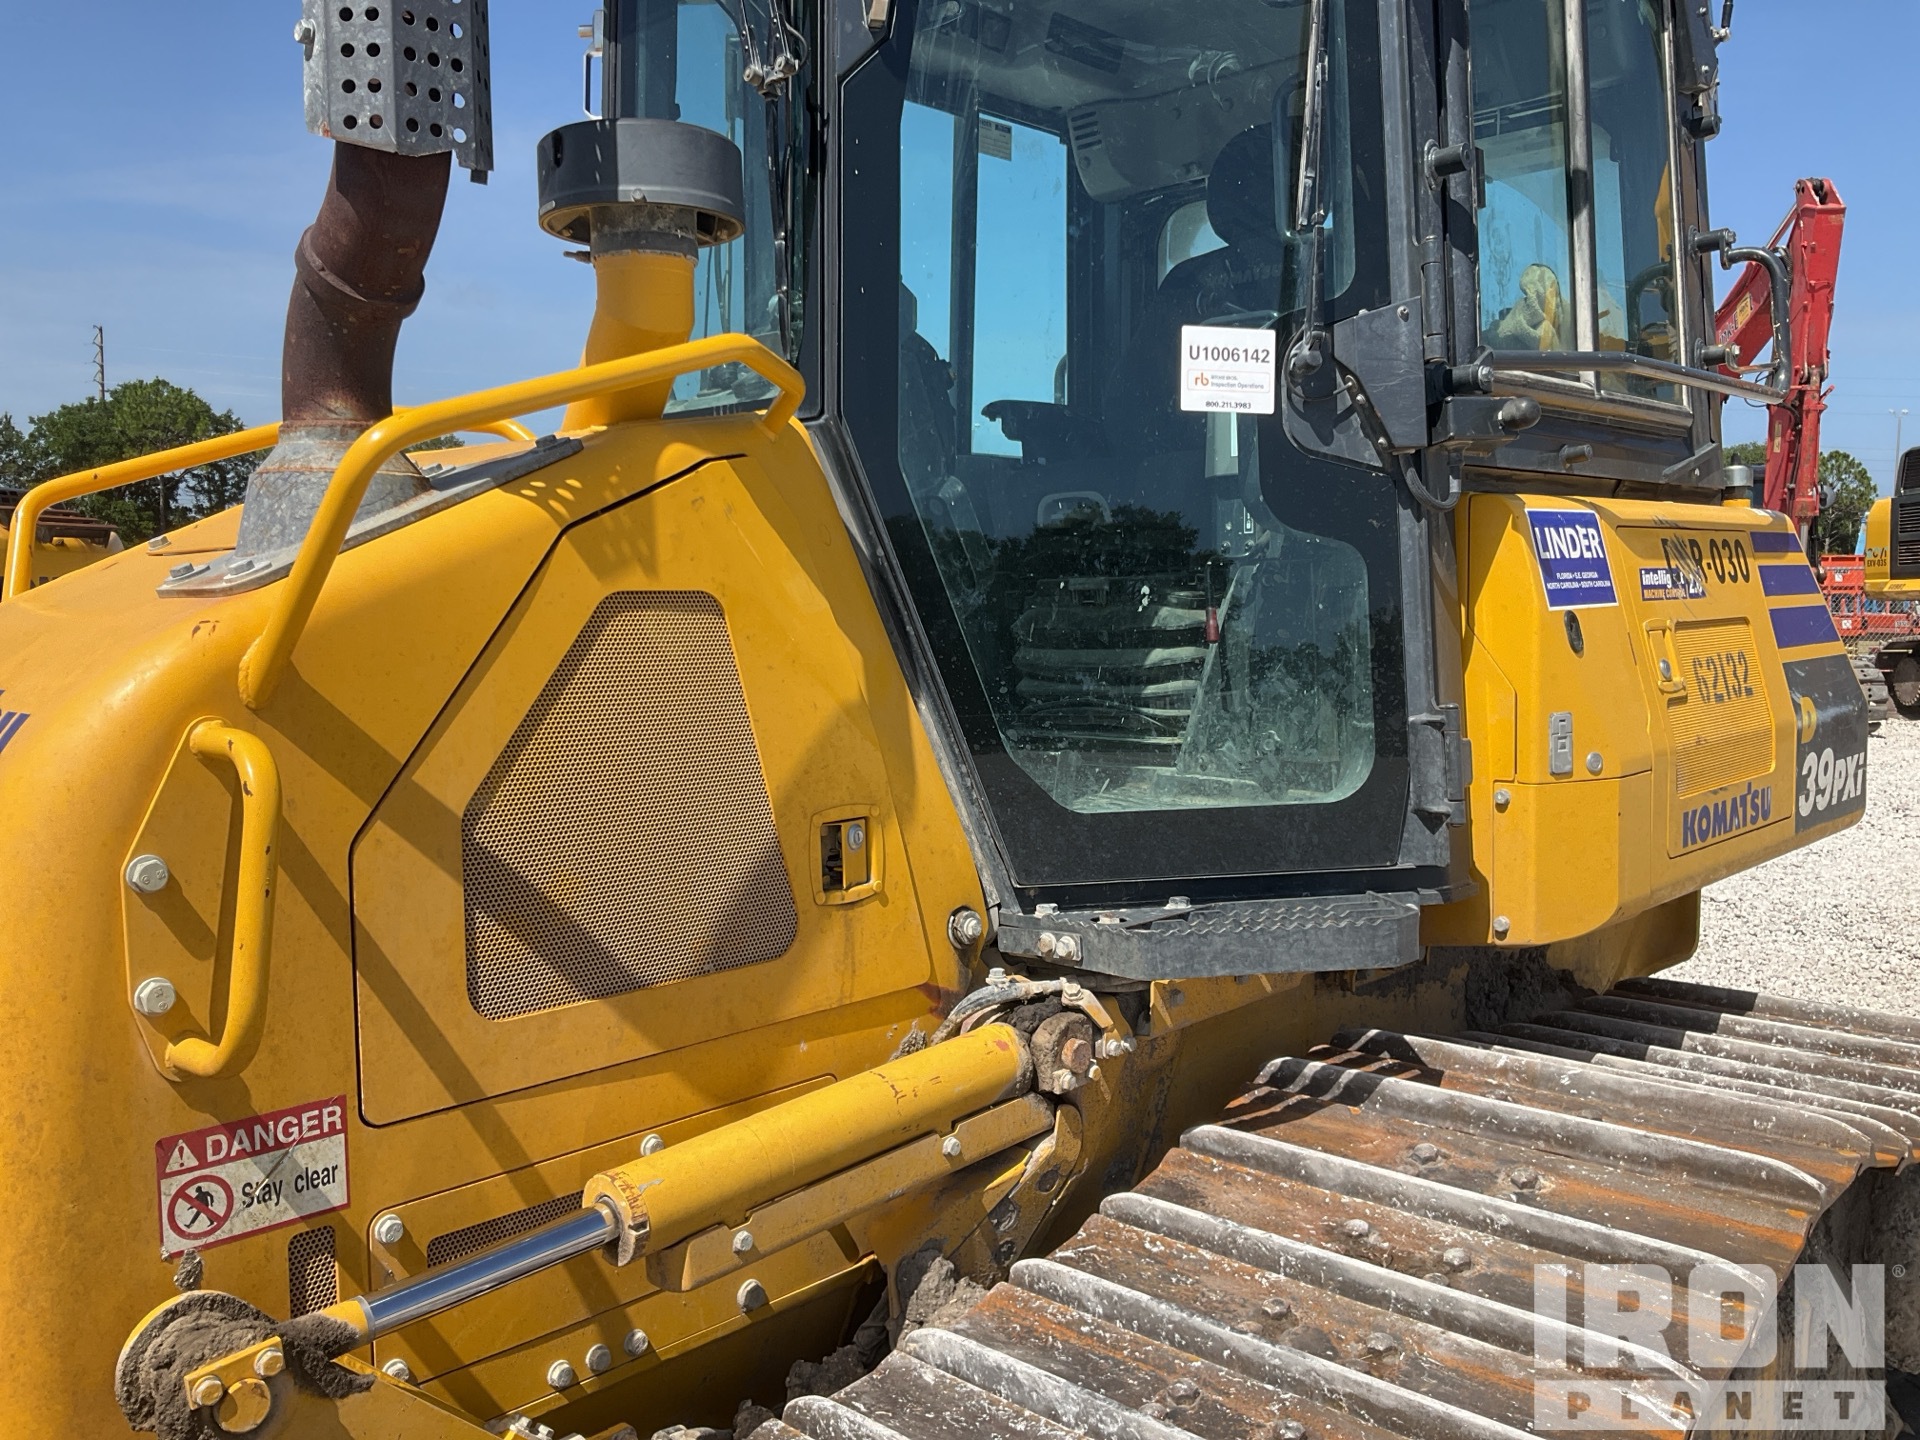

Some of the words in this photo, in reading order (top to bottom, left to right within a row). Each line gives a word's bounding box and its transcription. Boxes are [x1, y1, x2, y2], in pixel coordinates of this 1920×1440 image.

[1189, 345, 1270, 363] U1006142
[1194, 372, 1209, 386] rb
[1237, 382, 1264, 390] Operations
[1205, 401, 1251, 409] 800.211.3983
[1534, 525, 1604, 559] LINDER
[1547, 582, 1560, 590] NORTH
[1560, 581, 1579, 589] CAROLINA
[1692, 650, 1753, 704] 62132
[1799, 748, 1865, 817] 39PXi
[1683, 782, 1771, 848] KOMATSU
[205, 1105, 343, 1163] DANGER
[241, 1178, 282, 1208] Stay
[294, 1164, 338, 1194] clear
